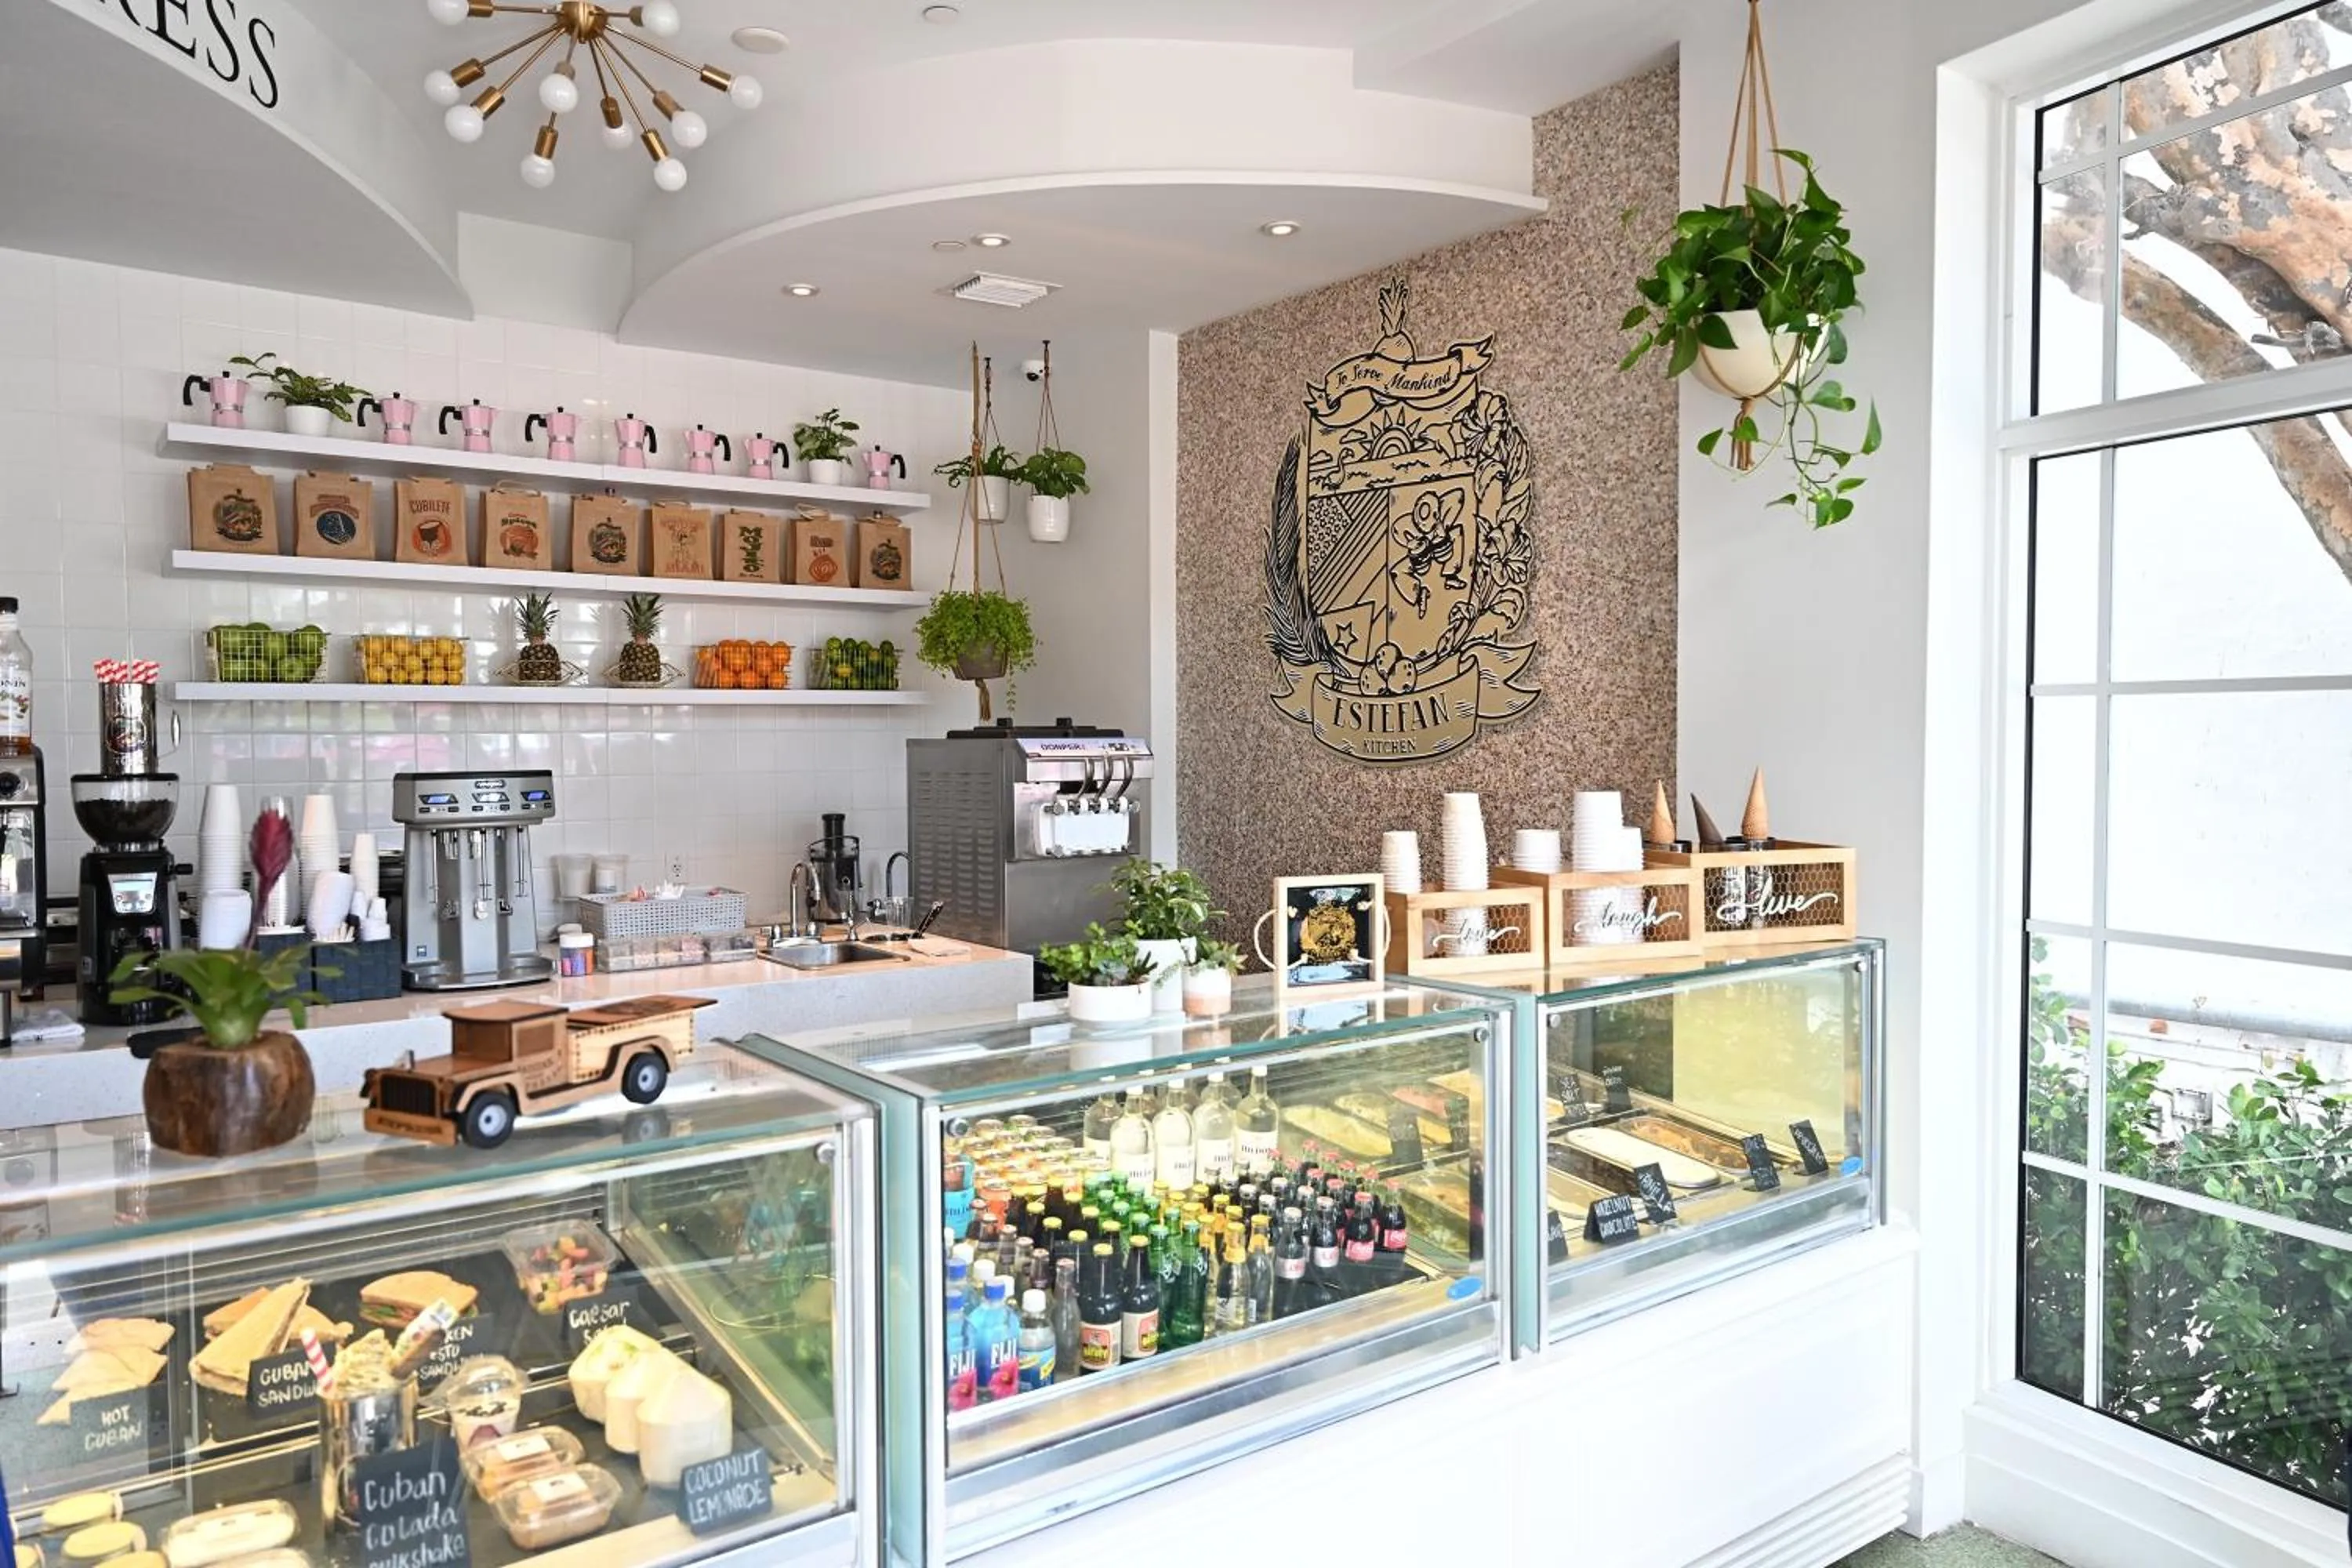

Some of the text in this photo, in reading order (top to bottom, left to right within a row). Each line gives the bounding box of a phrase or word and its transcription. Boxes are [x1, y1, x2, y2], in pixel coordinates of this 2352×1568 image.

[97, 0, 278, 108] ESS
[1336, 364, 1451, 395] To Serve Mankind
[1333, 691, 1450, 733] ESTEFAN
[1363, 738, 1416, 753] KITCHEN
[949, 1348, 976, 1378] FIJI
[991, 1338, 1018, 1368] FIJI
[101, 1404, 131, 1427] HOT
[85, 1420, 142, 1452] CUBAN
[685, 1448, 764, 1494] COCONUT
[365, 1471, 447, 1512] Cuban
